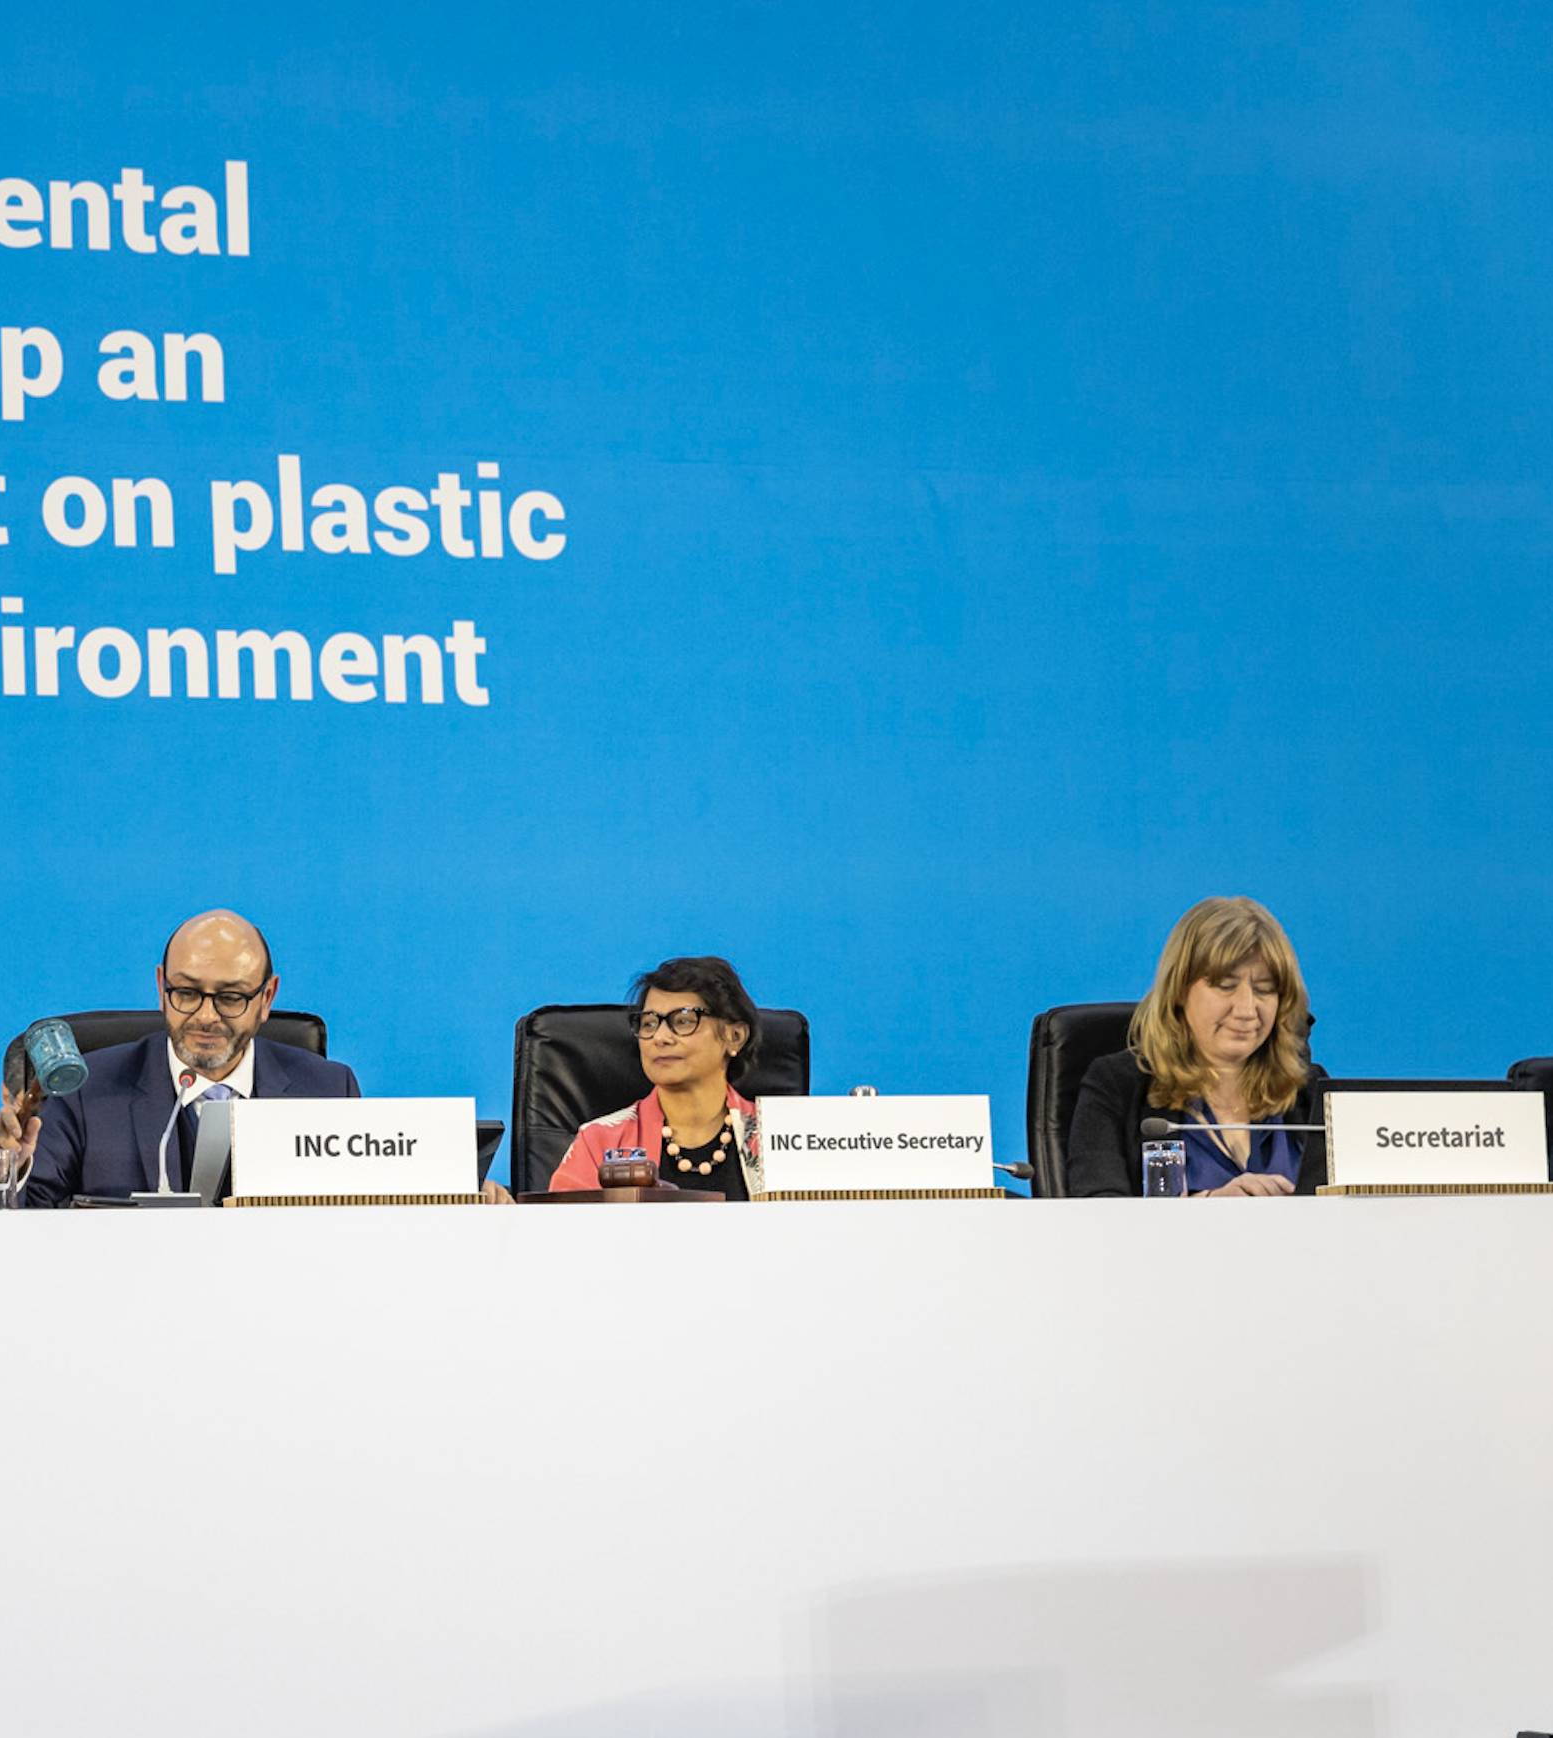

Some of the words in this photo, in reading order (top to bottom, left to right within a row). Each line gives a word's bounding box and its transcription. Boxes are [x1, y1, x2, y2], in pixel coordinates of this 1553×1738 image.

[97, 329, 225, 403] an
[41, 475, 175, 548] on
[210, 454, 567, 575] plastic
[294, 1132, 341, 1157] INC
[347, 1131, 418, 1157] Chair
[770, 1133, 802, 1152] INC
[806, 1132, 893, 1152] Executive
[897, 1131, 985, 1154] Secretary
[1375, 1124, 1506, 1149] Secretariat
